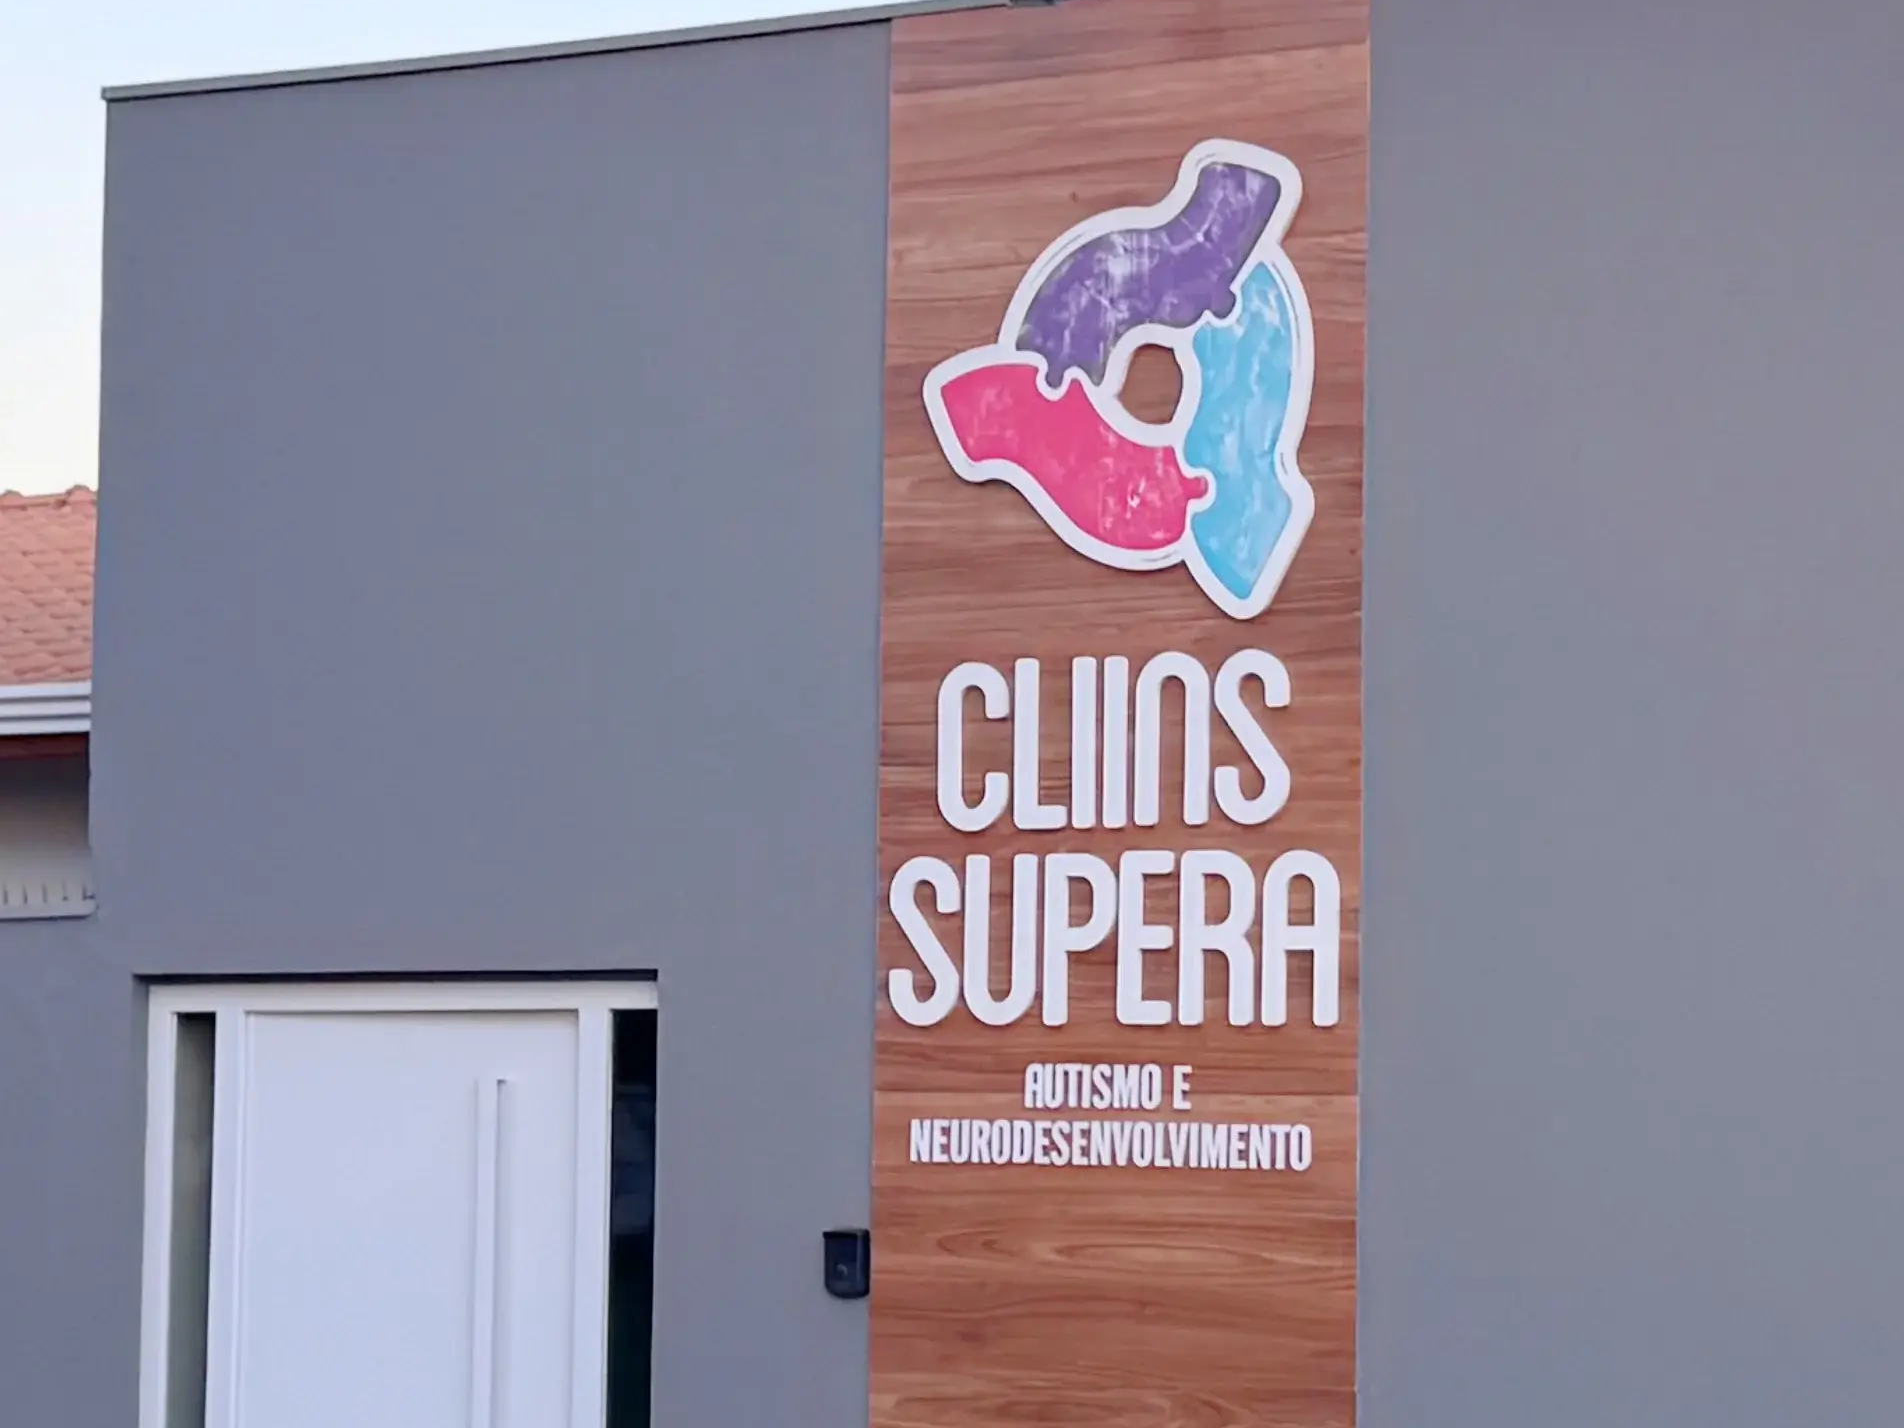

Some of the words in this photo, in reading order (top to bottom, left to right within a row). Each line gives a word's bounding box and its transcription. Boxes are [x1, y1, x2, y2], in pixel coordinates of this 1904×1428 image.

[888, 849, 1341, 1028] SUPERA
[1024, 1062, 1163, 1111] AUTISMO
[1172, 1064, 1194, 1111] E
[908, 1118, 1313, 1172] NEURODESENVOLVIMENTO
